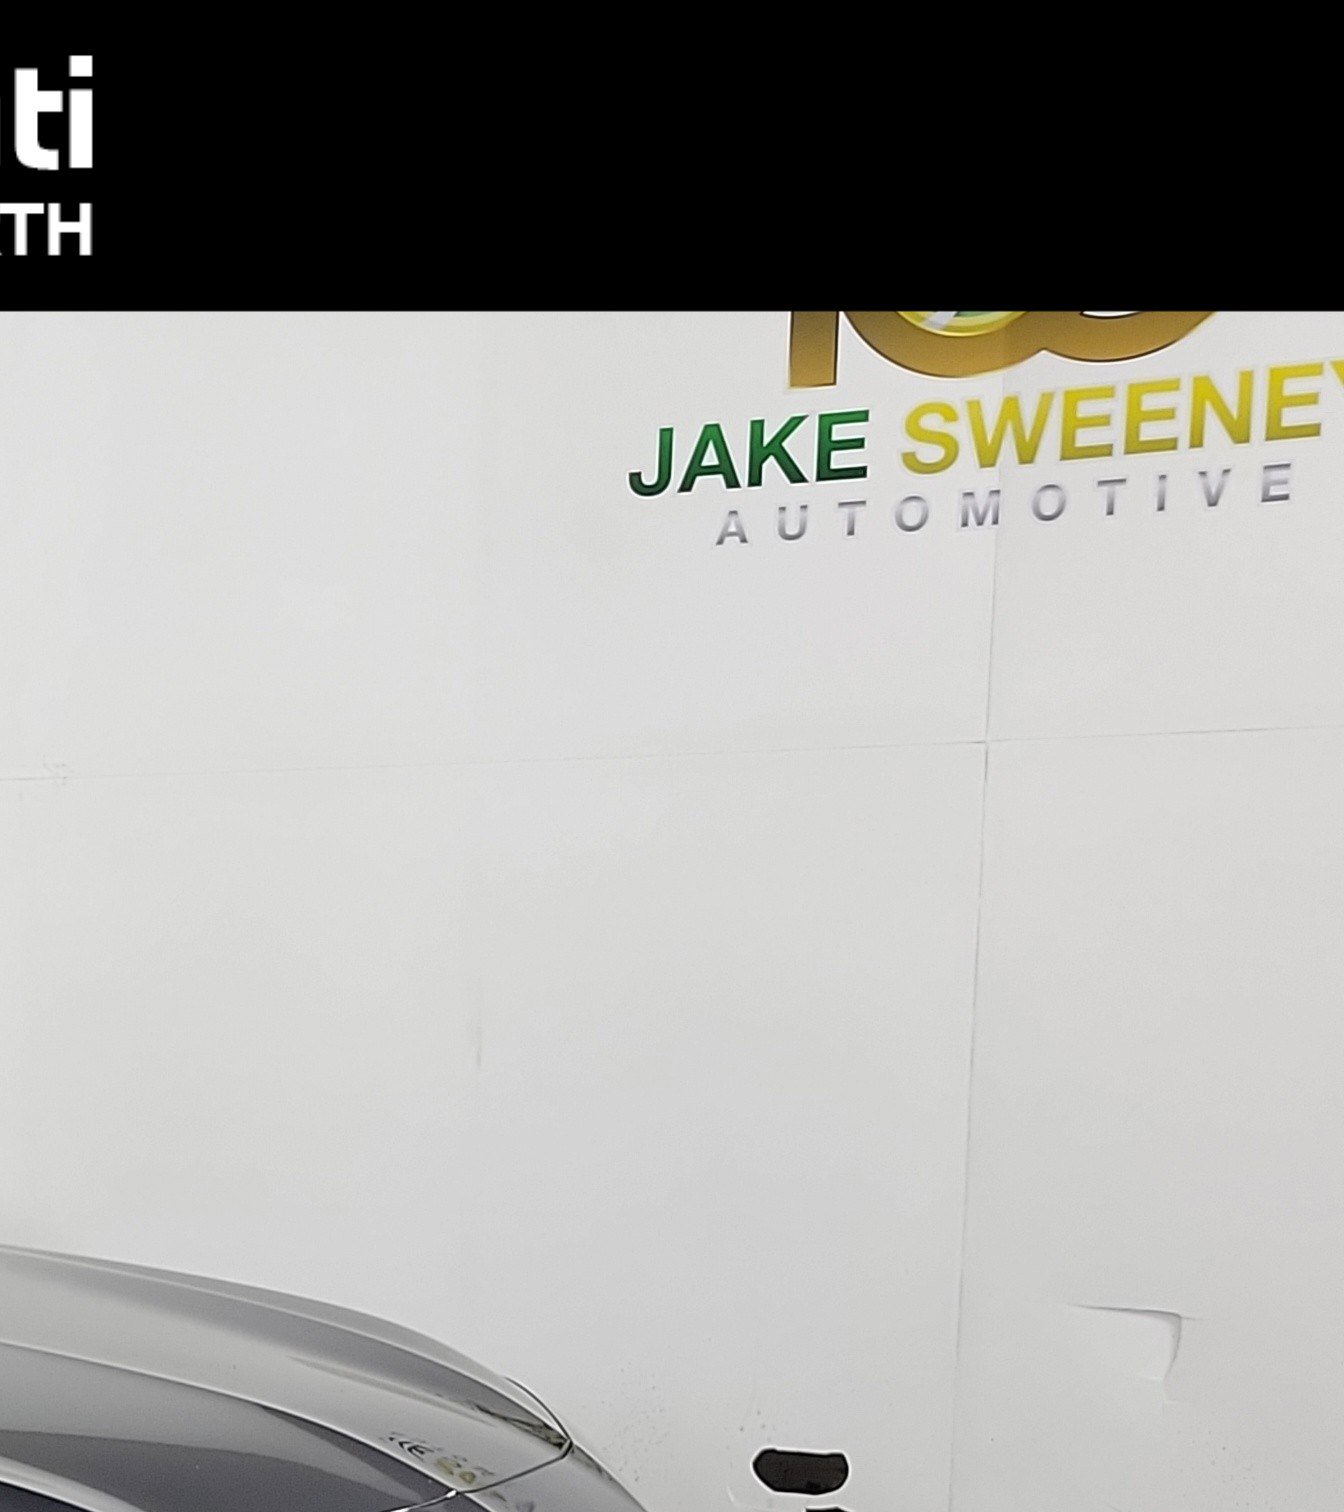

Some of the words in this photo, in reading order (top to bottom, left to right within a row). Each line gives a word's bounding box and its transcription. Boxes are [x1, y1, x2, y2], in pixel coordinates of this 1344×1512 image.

[627, 409, 870, 497] JAKE
[900, 359, 1344, 475] SWEENE
[714, 463, 1293, 546] AUTOMOTIVE
